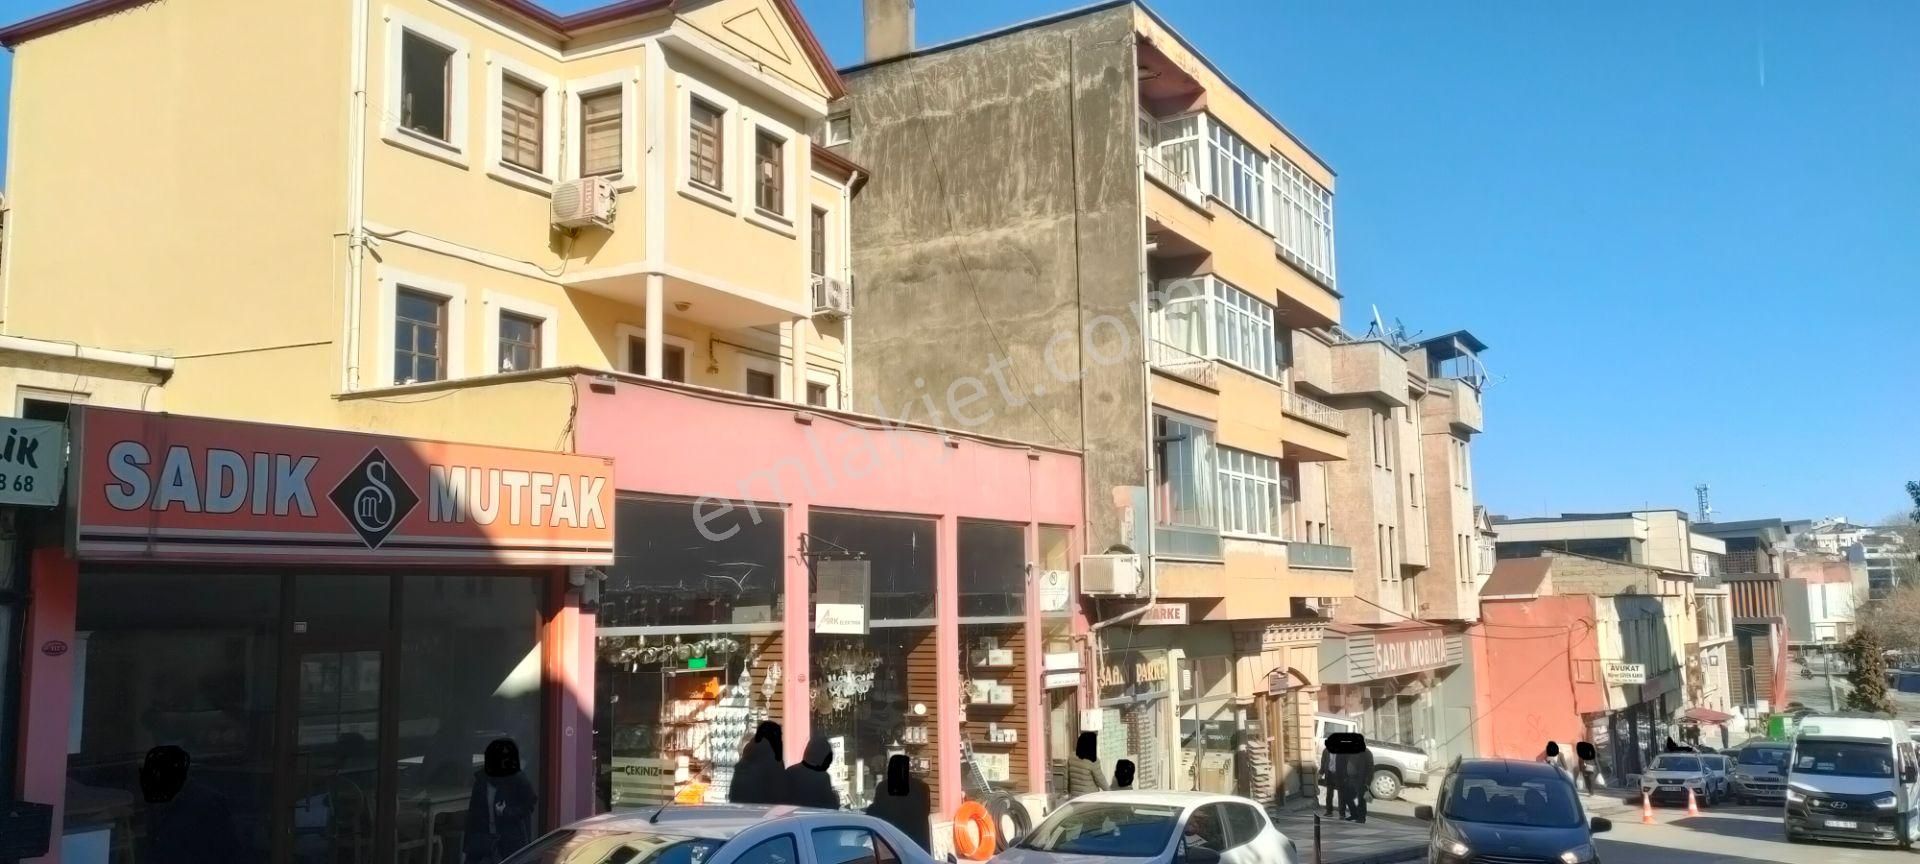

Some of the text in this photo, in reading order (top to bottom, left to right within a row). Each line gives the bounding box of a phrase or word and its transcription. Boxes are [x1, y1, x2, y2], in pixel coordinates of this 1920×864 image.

[0, 428, 38, 469] İK
[13, 474, 34, 492] 68
[104, 440, 607, 530] SADIK MUTFAK
[1147, 608, 1181, 620] PARKE
[1376, 641, 1407, 673] SADIK
[1136, 660, 1167, 683] PARKE
